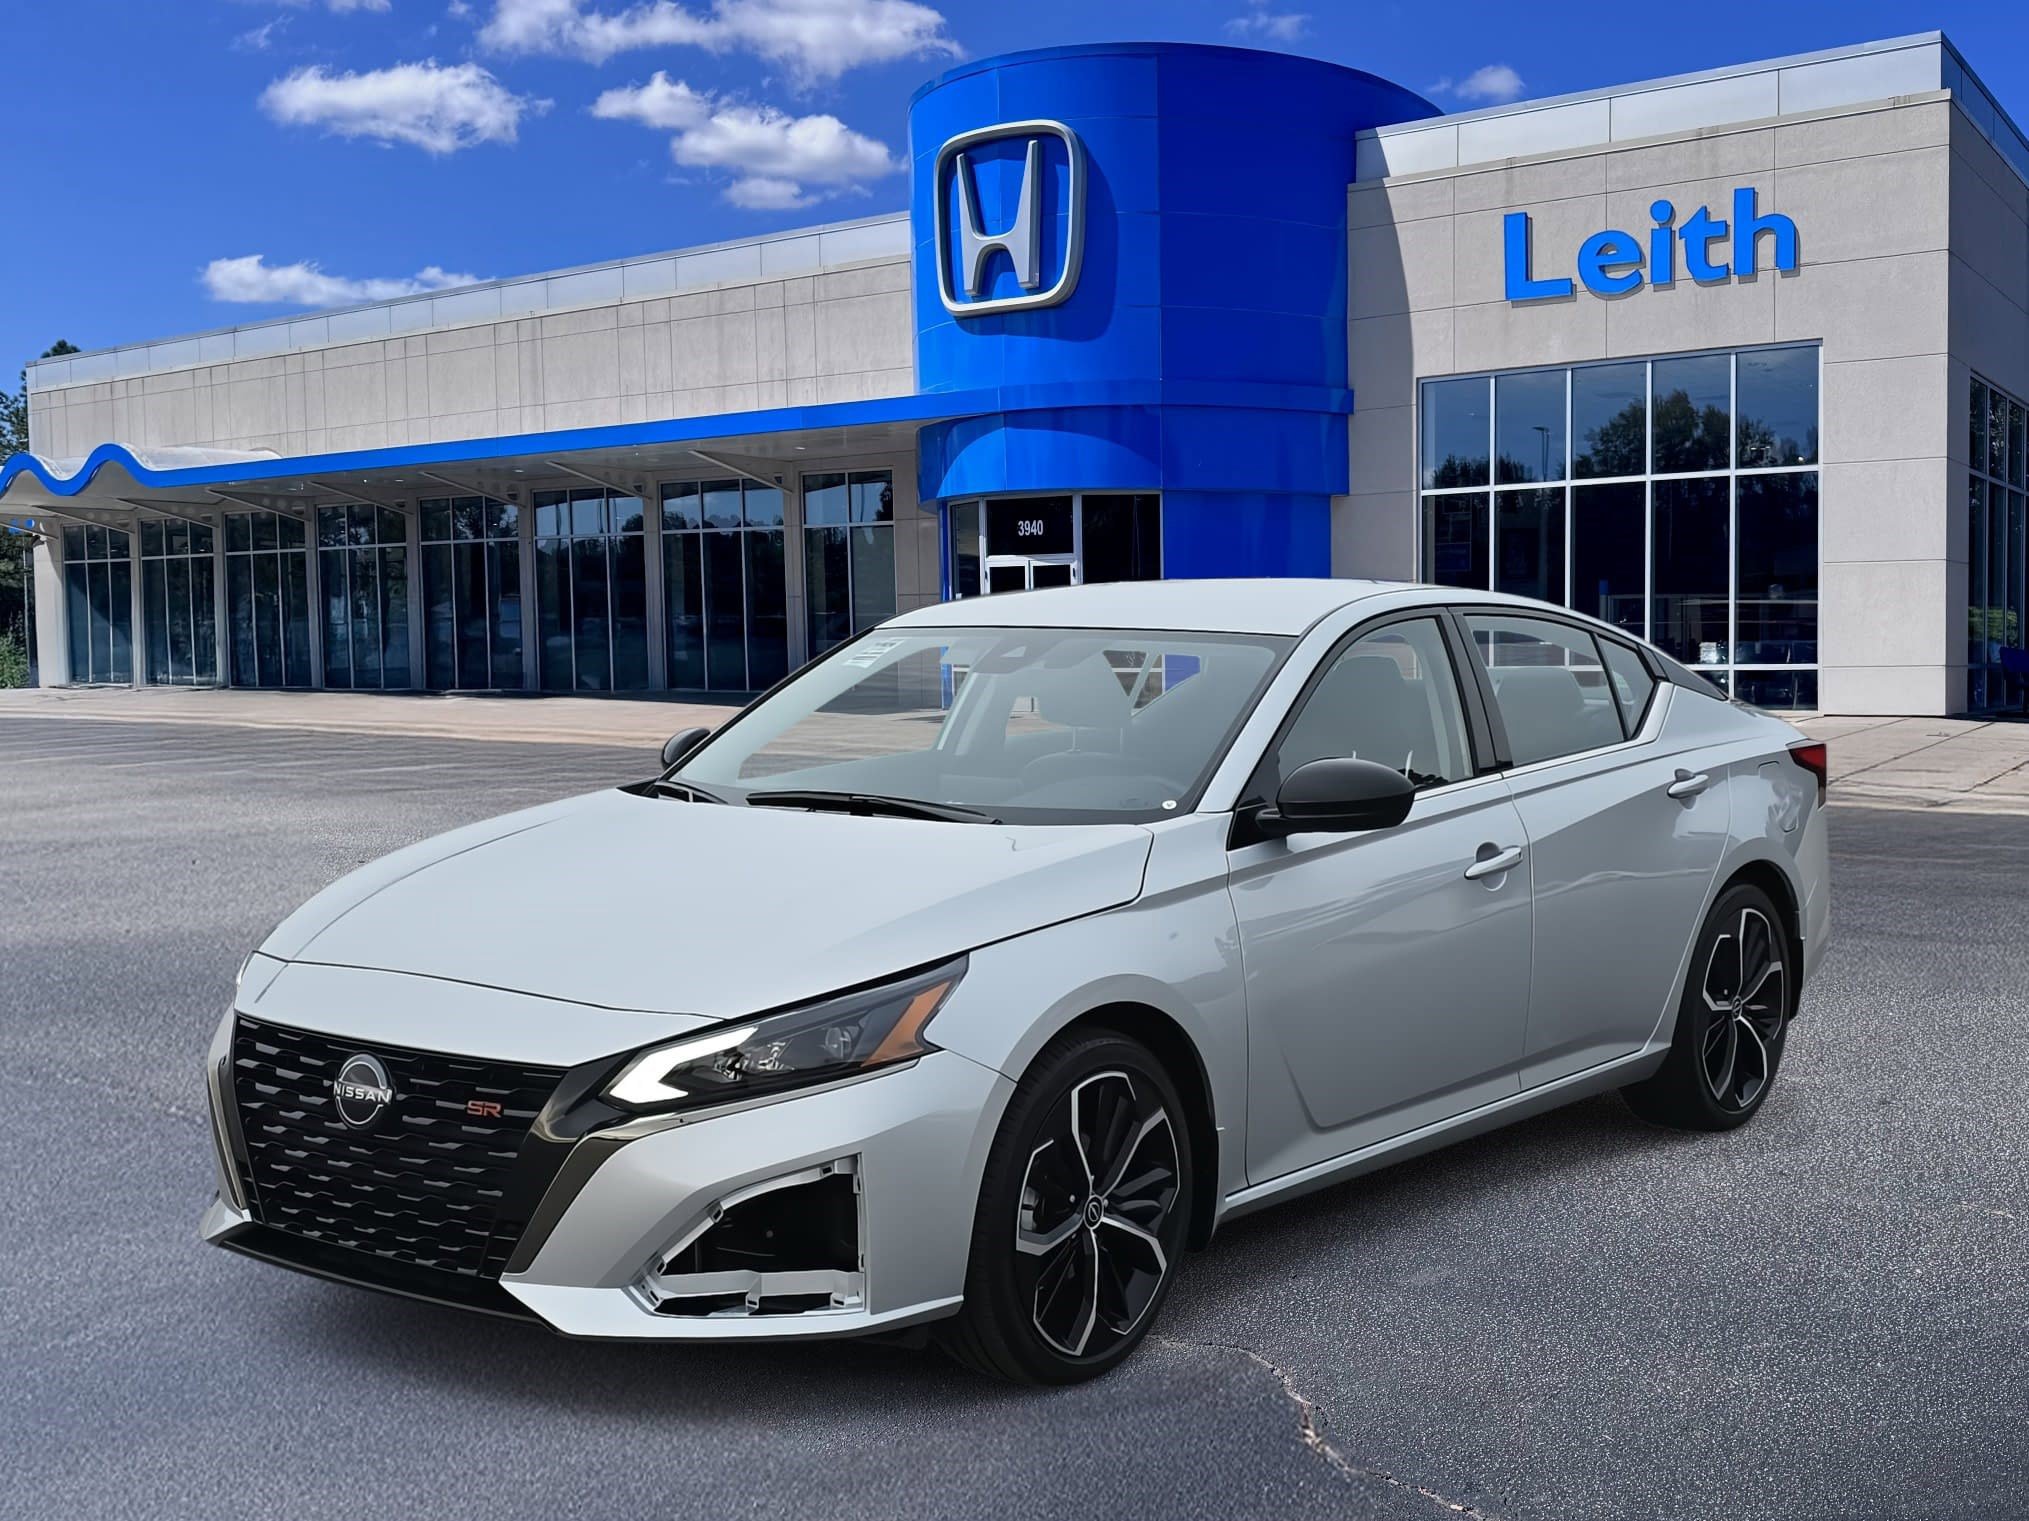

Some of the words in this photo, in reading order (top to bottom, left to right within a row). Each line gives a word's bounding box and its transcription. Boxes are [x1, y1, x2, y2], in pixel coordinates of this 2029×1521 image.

[1504, 187, 1797, 301] Leith
[1018, 520, 1043, 536] 3940
[333, 1080, 392, 1103] NISSAN
[467, 1100, 501, 1118] SR
